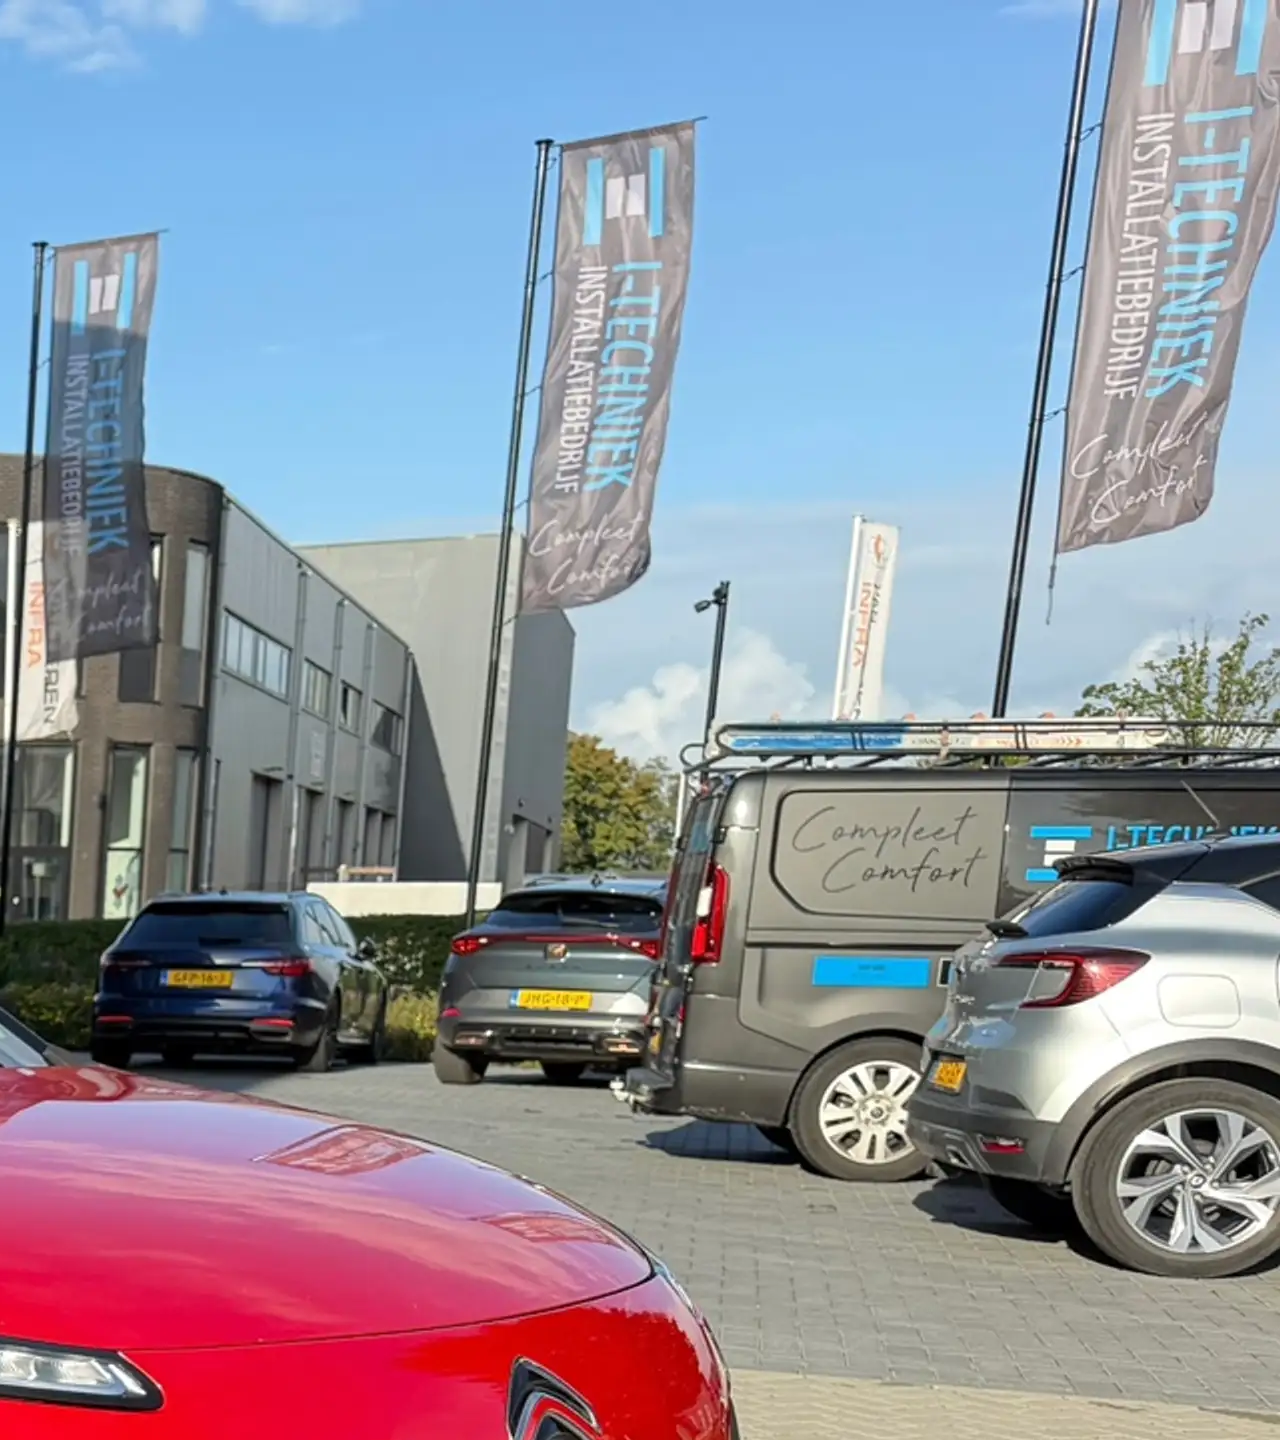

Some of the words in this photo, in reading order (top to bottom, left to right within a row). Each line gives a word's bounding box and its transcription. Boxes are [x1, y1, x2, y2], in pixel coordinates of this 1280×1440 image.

[1104, 112, 1175, 401] INSTALLATIEBEDRIJF
[1144, 106, 1253, 398] I-TECHNIEK
[86, 348, 130, 556] I-TECHNIEK
[555, 265, 608, 493] INSTALLATIEBEDRIJF
[584, 261, 662, 491] I-TECHNIEK
[792, 806, 978, 858] Compleet
[822, 847, 988, 893] Comfort
